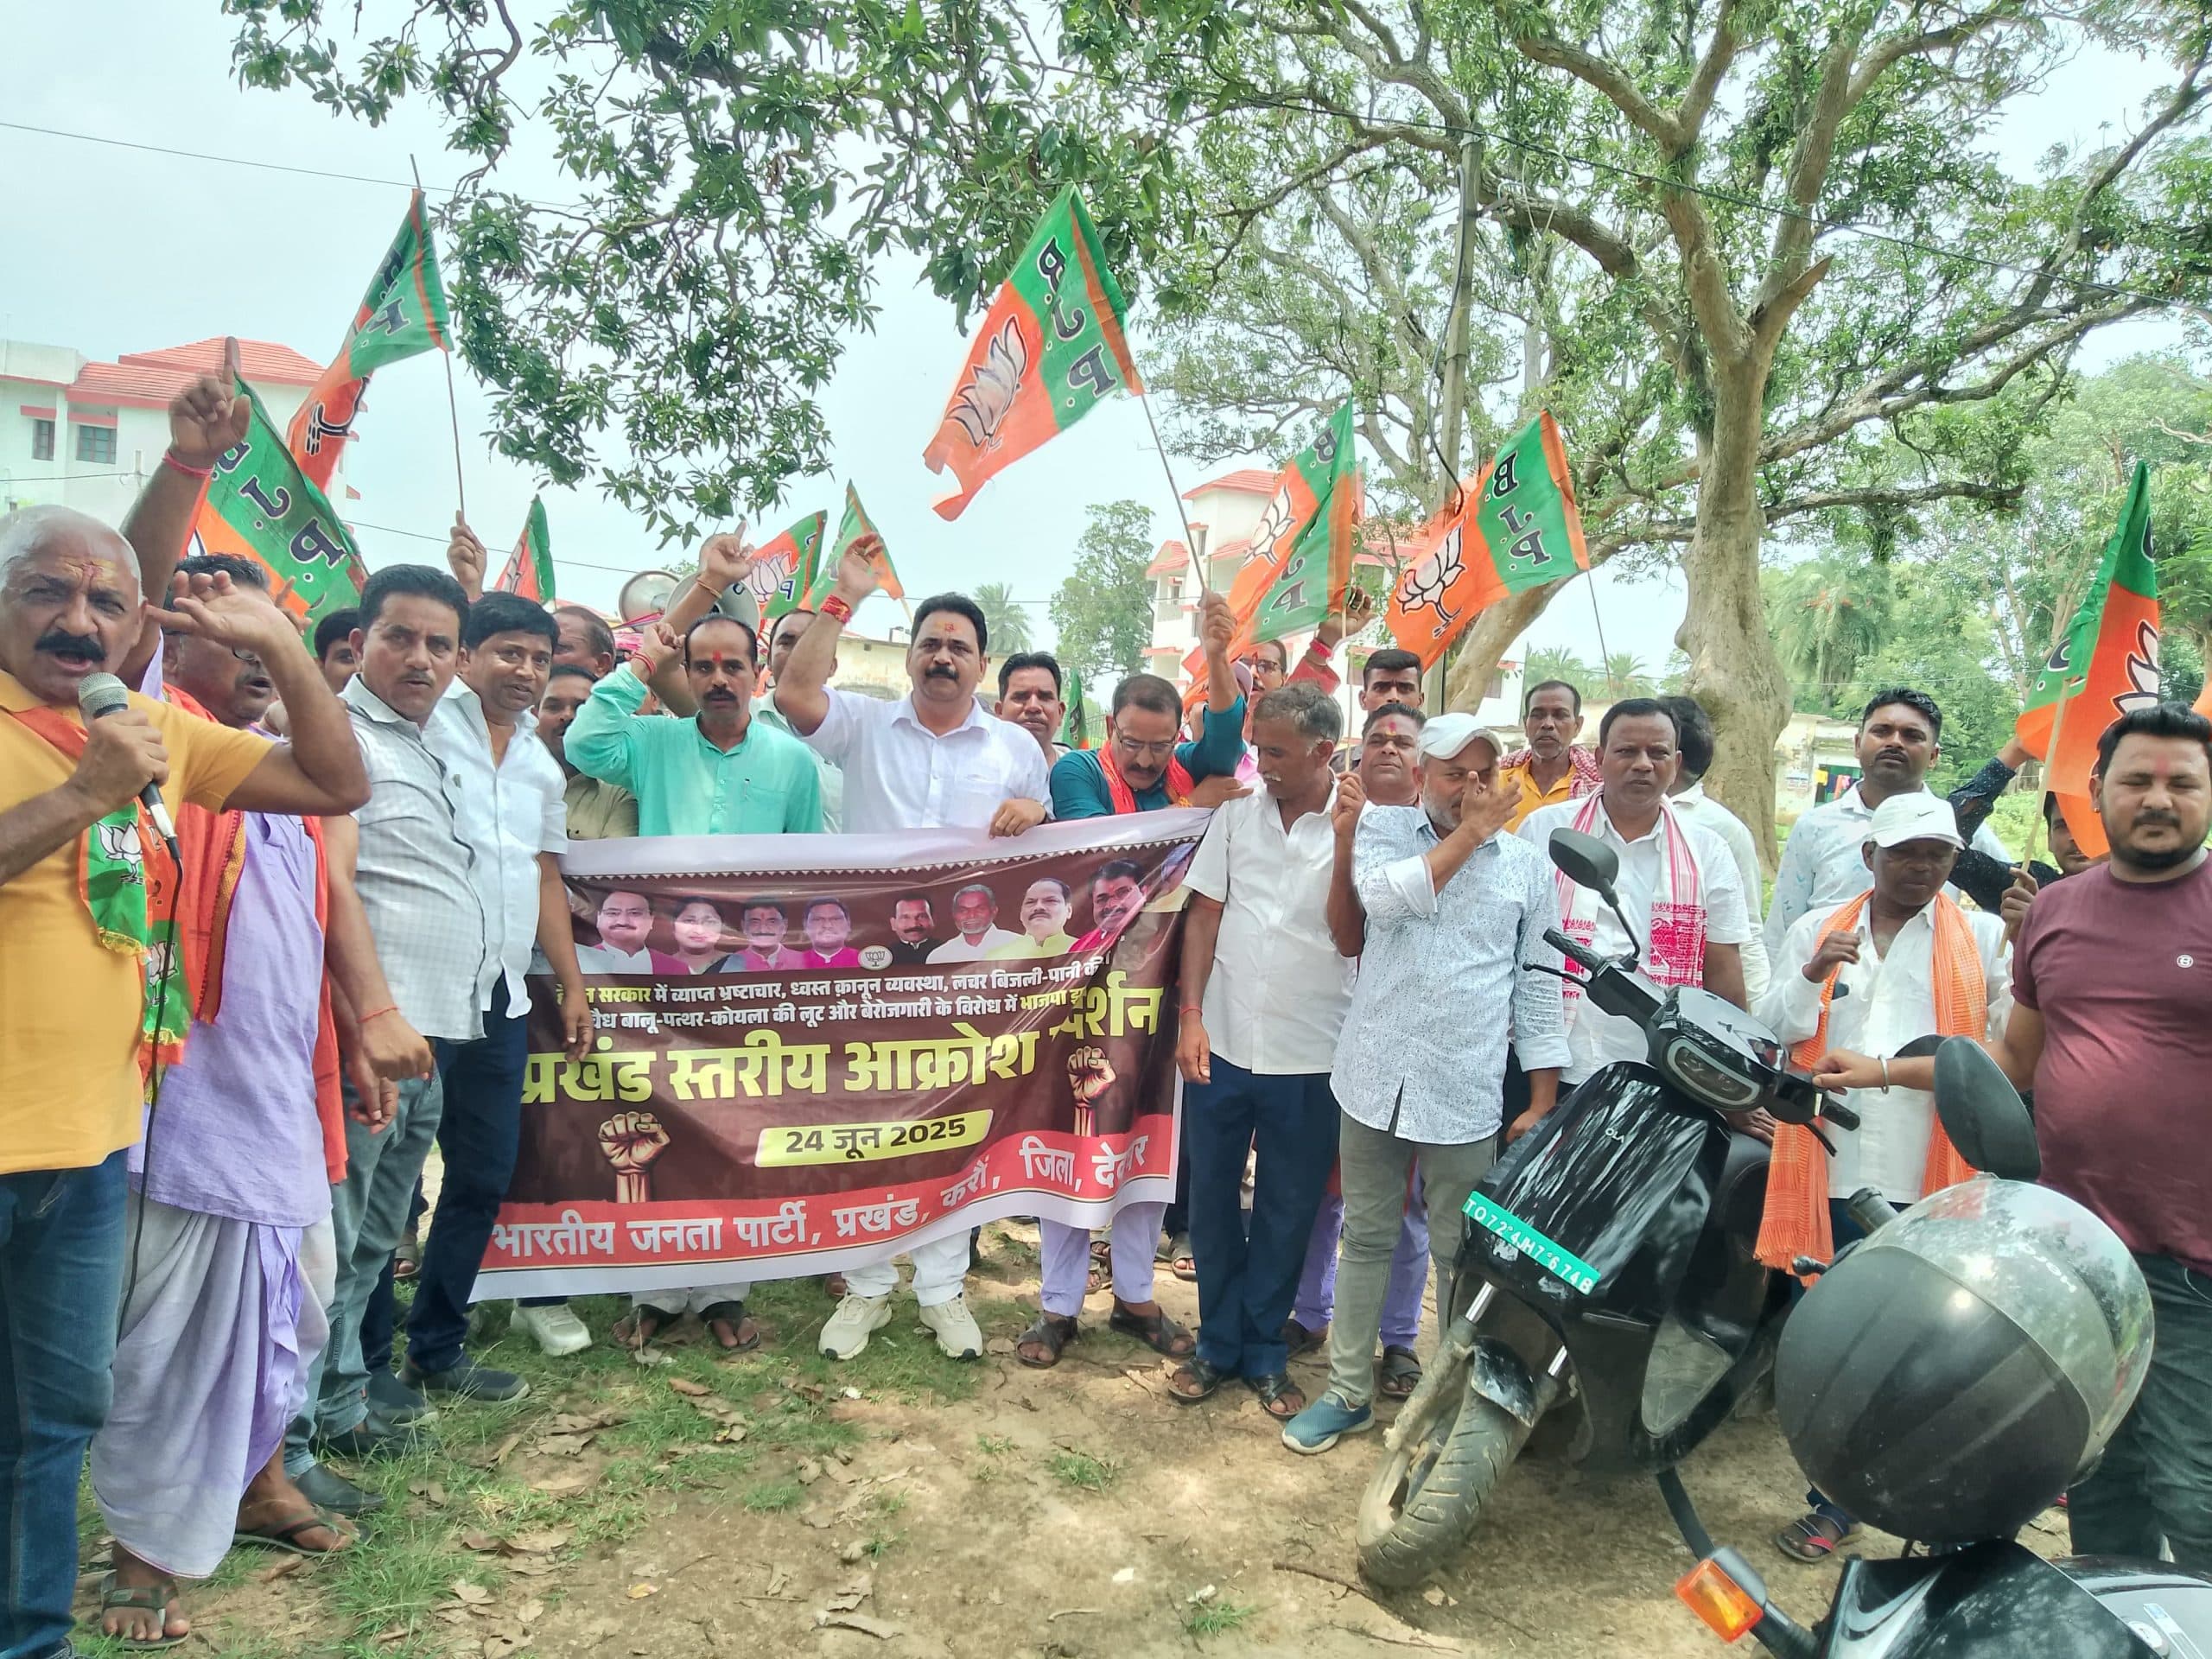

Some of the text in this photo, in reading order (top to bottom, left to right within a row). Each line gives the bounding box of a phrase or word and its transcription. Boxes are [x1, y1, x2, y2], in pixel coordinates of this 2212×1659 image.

[598, 986, 651, 1003] सरकार
[654, 983, 668, 1003] में
[671, 986, 715, 1003] व्याप्त
[719, 982, 787, 1001] भ्रष्टाचार,
[791, 980, 830, 997] ध्वस्त
[885, 975, 949, 994] व्यवस्था,
[951, 974, 988, 990] लचर
[990, 960, 1082, 989] बिजली-पानी
[590, 1007, 617, 1029] वैध
[620, 1006, 770, 1033] बालू-पत्थर-कोयला
[772, 1002, 796, 1023] की
[799, 1005, 824, 1027] लूट
[829, 999, 857, 1020] और
[861, 995, 931, 1020] बेरोजगारी
[935, 996, 952, 1017] के
[956, 994, 1001, 1017] विरोध
[1005, 994, 1018, 1013] में
[1020, 989, 1067, 1010] भाजपा
[520, 1036, 657, 1104] प्रखंड
[666, 1029, 830, 1100] स्तरीय
[844, 1022, 1039, 1091] आक्रोश
[786, 1117, 966, 1159] 24 जून 2025
[1605, 1128, 1624, 1143] OLA
[493, 1209, 615, 1257] भारतीय
[626, 1217, 723, 1253] जनता
[733, 1200, 821, 1249] पार्टी,
[832, 1193, 929, 1237] प्रखंड,
[1019, 1135, 1082, 1192] जिला,
